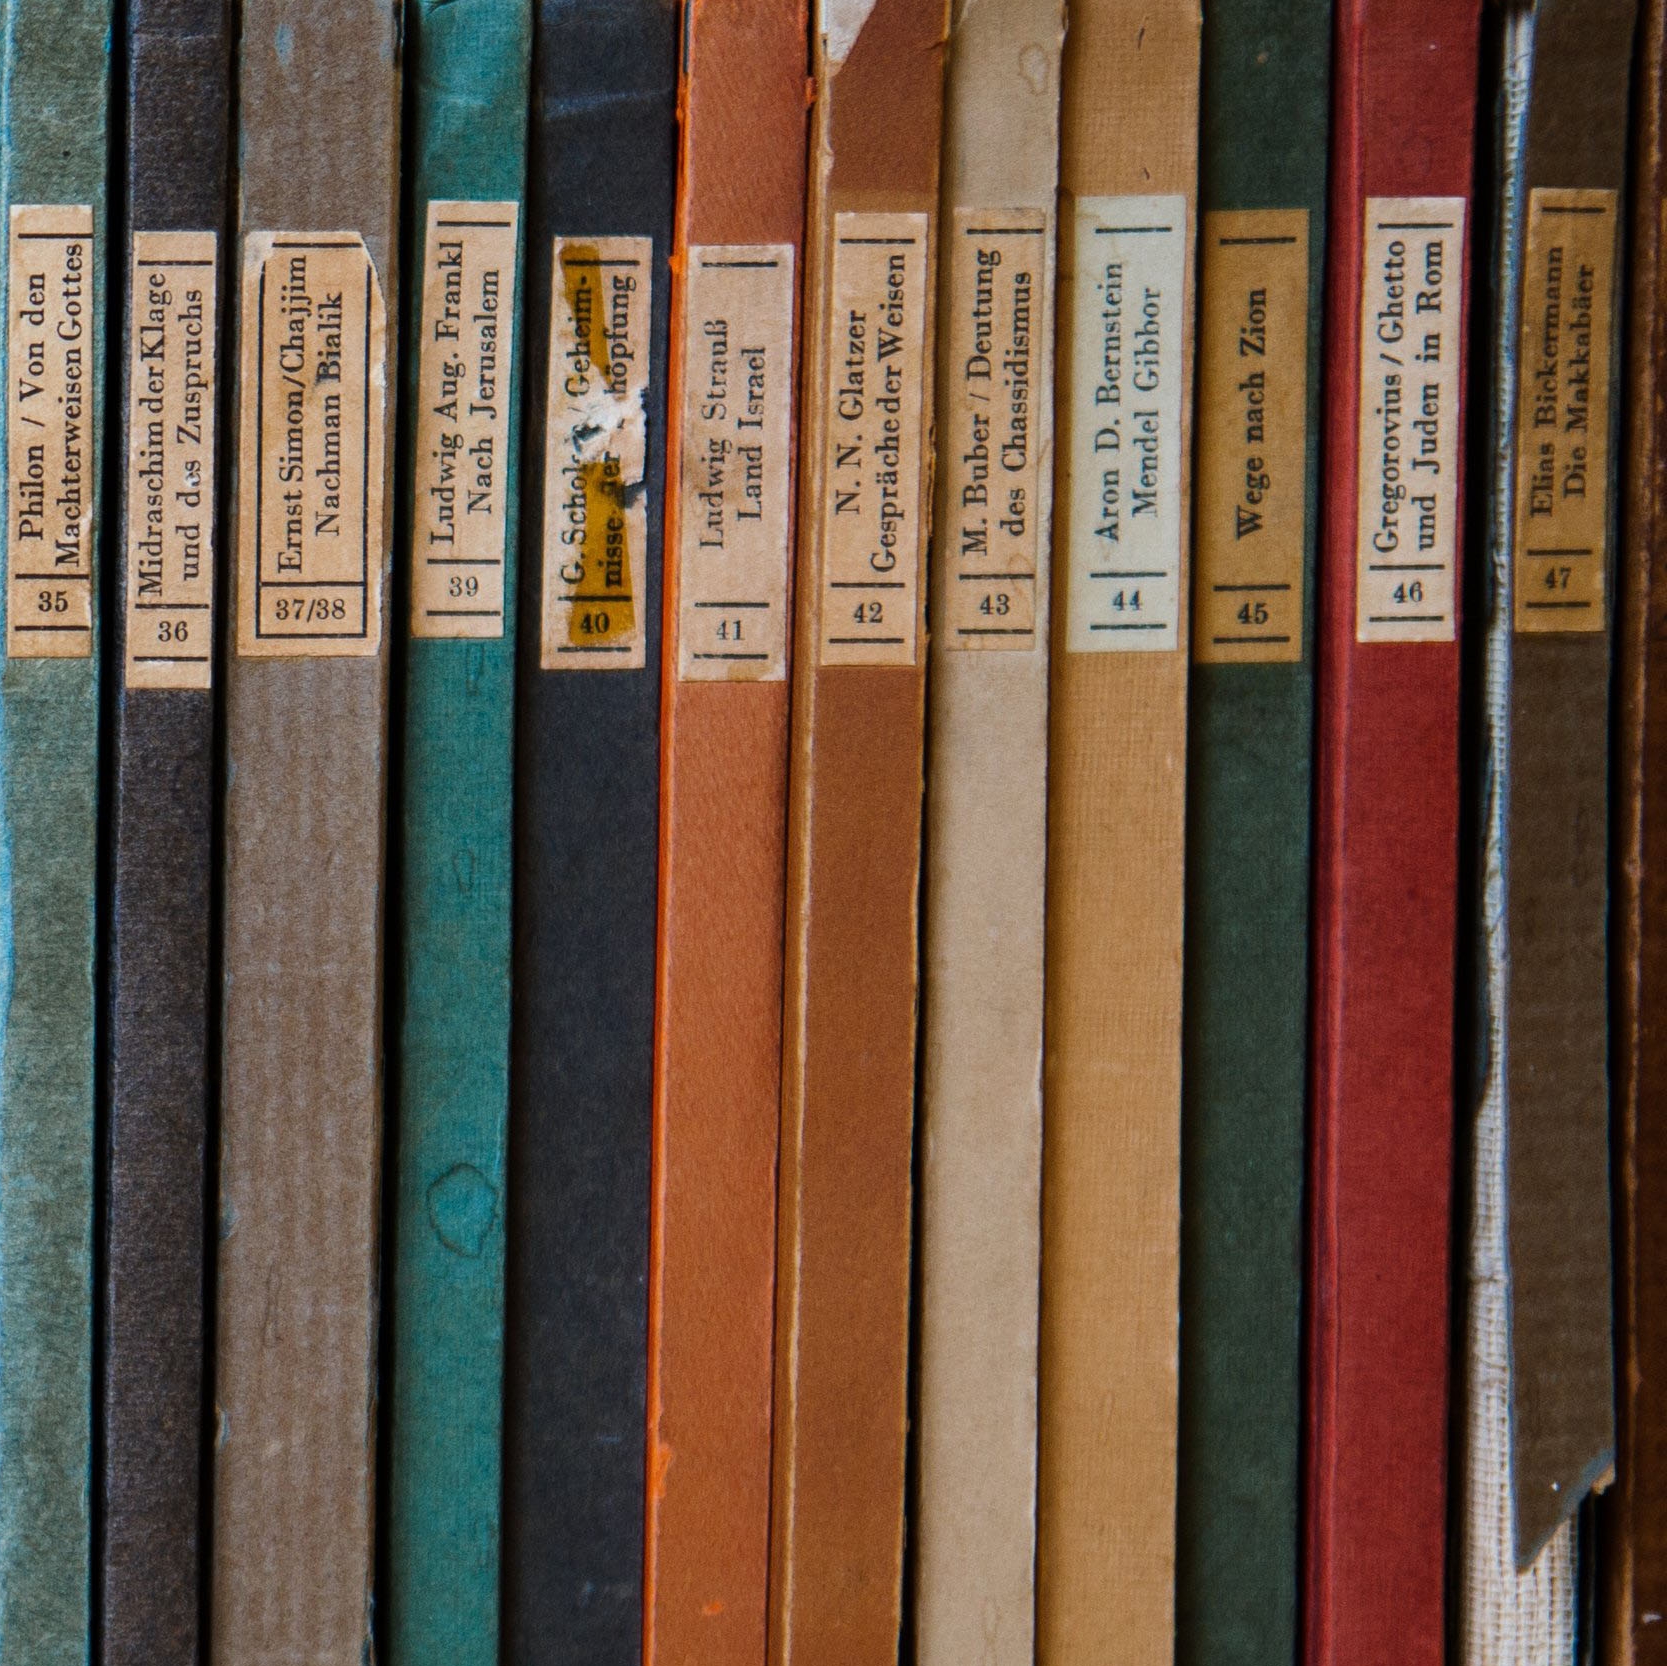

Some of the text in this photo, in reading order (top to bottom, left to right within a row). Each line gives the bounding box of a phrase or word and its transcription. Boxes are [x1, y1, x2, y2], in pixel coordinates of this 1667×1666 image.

[19, 273, 45, 540] Philon Von den
[55, 244, 82, 567] Machterweisen Gottes
[138, 274, 172, 597] Midraschim der Klage
[175, 290, 208, 581] und Zuspruchs
[278, 256, 312, 573] Ernst Simon/Chajjim
[315, 292, 342, 536] Nachman Bialik
[429, 241, 466, 545] Ludwig Aug. Frankl
[467, 270, 499, 514] Nach Jerusalem
[698, 320, 732, 548] Ludwig Strauß
[737, 347, 765, 521] Land Israel
[835, 310, 866, 515] N. N. Glatzer
[870, 255, 905, 572] Gespräche der Weisen
[962, 249, 1001, 555] M. Buber Deutung
[1000, 272, 1031, 536] des Chassidismus
[1094, 264, 1122, 542] Aron D. Bernstein
[1132, 288, 1160, 517] Mendel Gibbor
[1236, 288, 1270, 540] Wege nach Zion
[1373, 241, 1406, 553] Gregorovius Ghetto
[1412, 241, 1442, 551] und Juden in Rom
[38, 591, 68, 612] 35
[158, 621, 188, 642] 36
[276, 599, 345, 622] 37/38
[450, 577, 478, 597] 39
[854, 602, 883, 623] 42
[980, 594, 1010, 615] 43
[1113, 591, 1140, 611] 44
[1238, 603, 1268, 624] 45
[1394, 581, 1423, 603] 46
